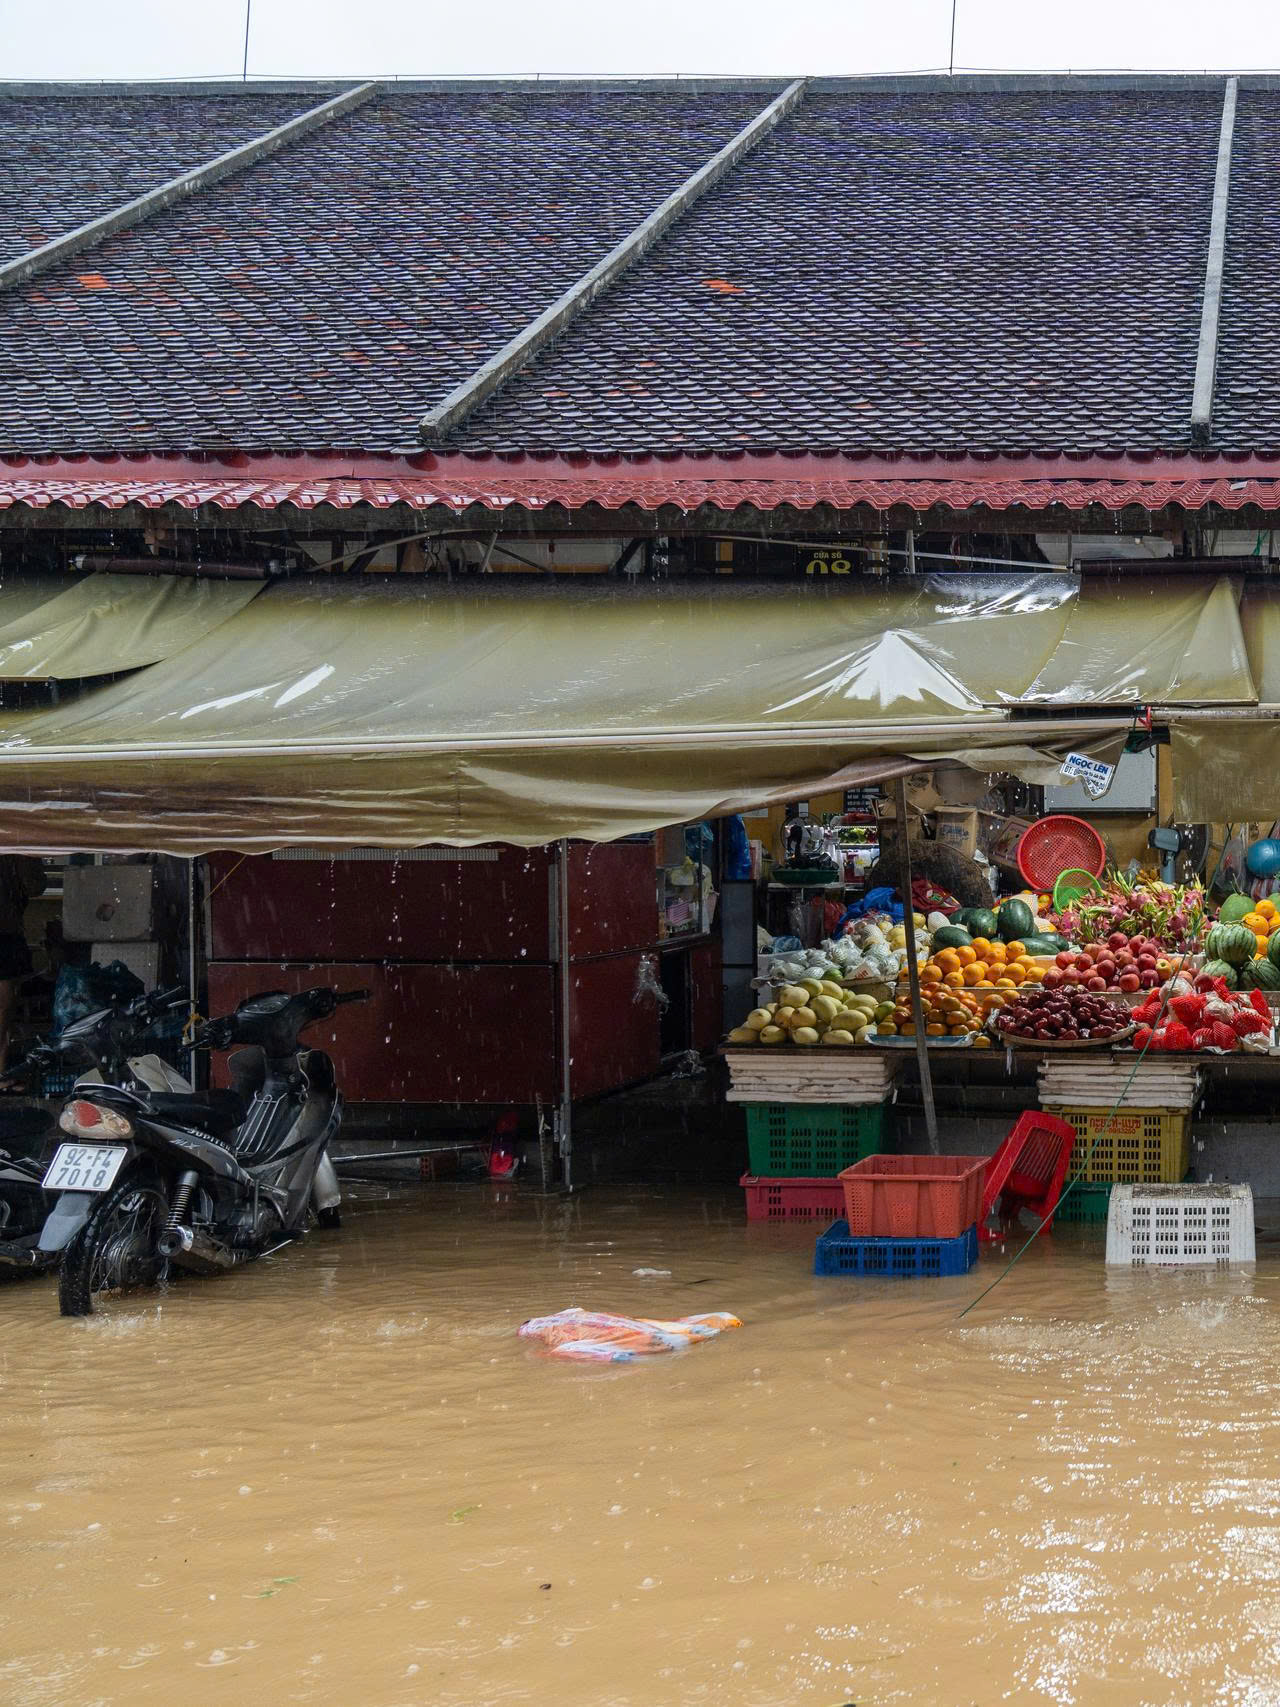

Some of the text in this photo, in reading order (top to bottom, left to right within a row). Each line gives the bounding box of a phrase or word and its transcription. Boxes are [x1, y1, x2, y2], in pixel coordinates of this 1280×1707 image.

[1069, 756, 1093, 769] NGỌC
[64, 1148, 113, 1168] 92-F4
[55, 1167, 107, 1188] 7018
